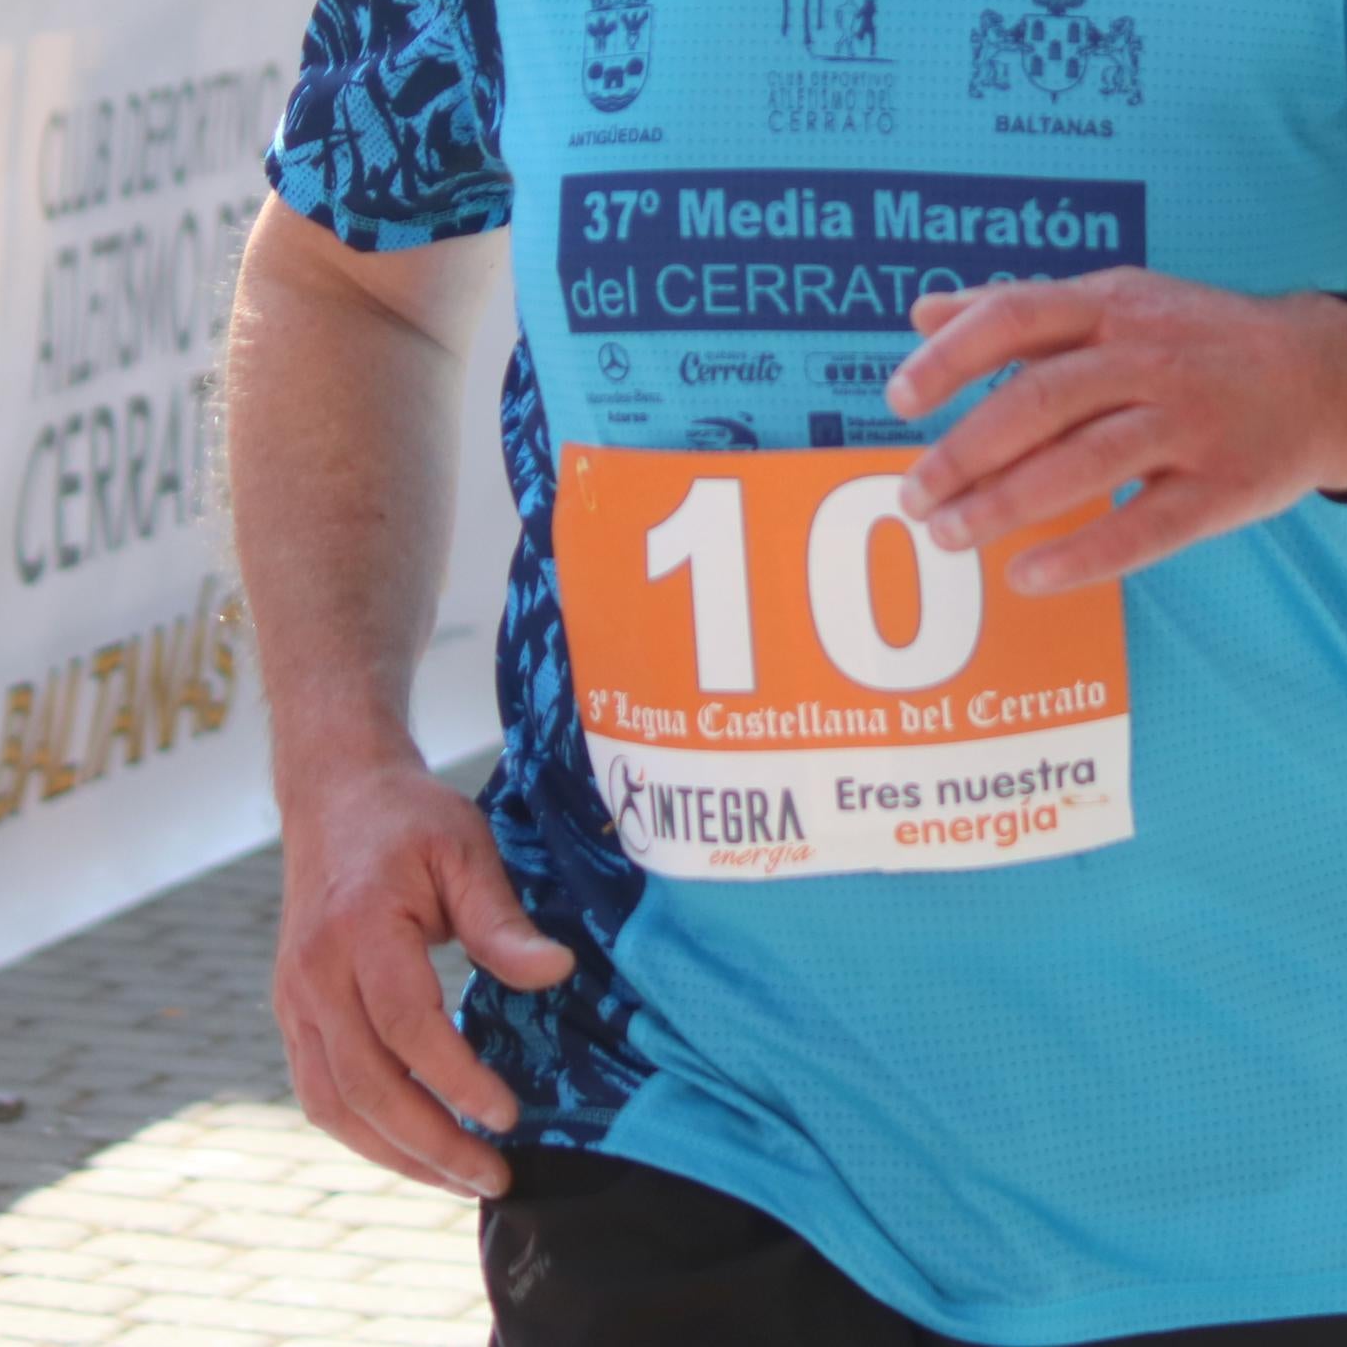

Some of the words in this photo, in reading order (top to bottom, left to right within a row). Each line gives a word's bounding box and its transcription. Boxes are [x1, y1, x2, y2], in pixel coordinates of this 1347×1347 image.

[768, 109, 894, 134] CERRATO
[679, 189, 853, 239] Media
[874, 191, 1120, 250] Maratón
[570, 265, 639, 317] del
[679, 350, 784, 386] Cerrato
[645, 473, 984, 694] 10
[613, 689, 688, 741] Legua
[696, 701, 888, 740] Castellana
[899, 695, 953, 734] del
[966, 678, 1108, 728] Cerrato
[649, 781, 806, 844] INTEGRA
[834, 775, 922, 811] Eres
[936, 756, 1096, 806] nuestra
